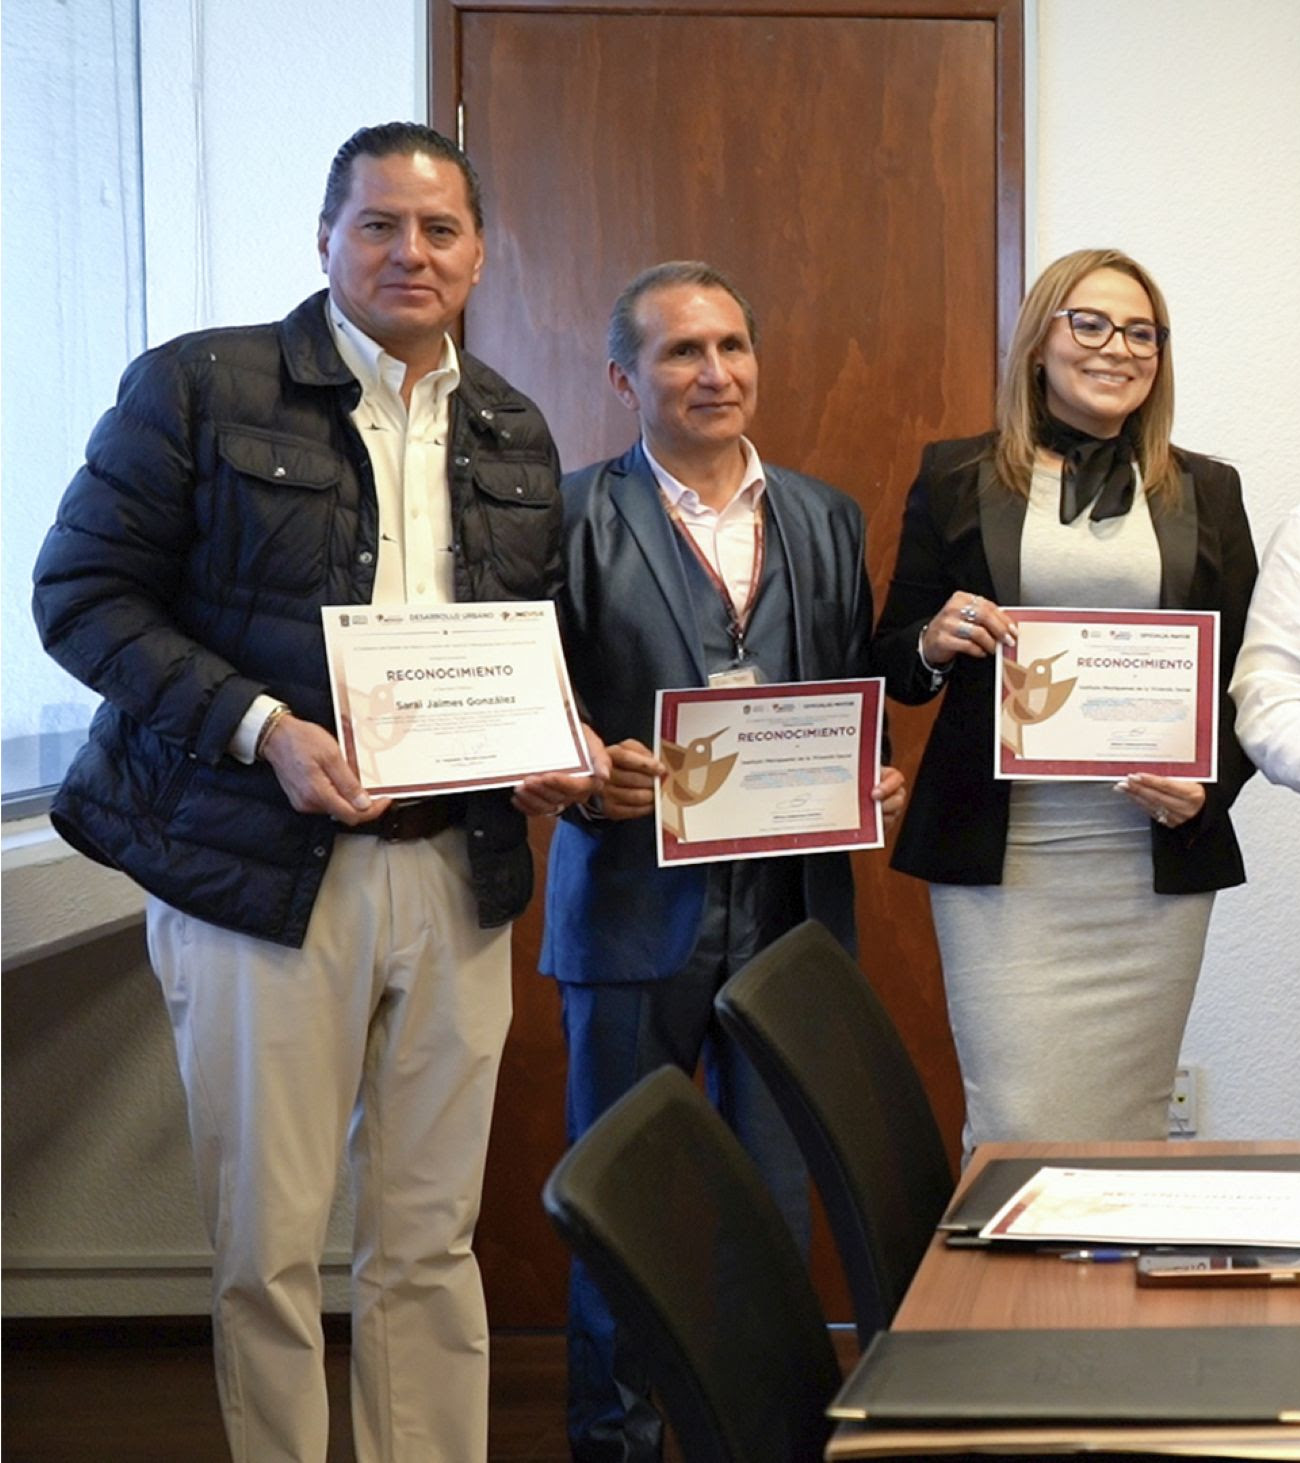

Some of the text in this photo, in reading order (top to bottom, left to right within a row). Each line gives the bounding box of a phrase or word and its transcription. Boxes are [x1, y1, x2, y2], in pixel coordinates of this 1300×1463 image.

[409, 613, 461, 622] DESARROLLO
[463, 612, 495, 621] URBANO
[1077, 657, 1194, 670] RECONOCIMIENTO
[387, 665, 514, 682] RECONOCIMIENTO
[427, 698, 464, 709] Jaimes
[738, 726, 856, 742] RECONOCIMIENTO
